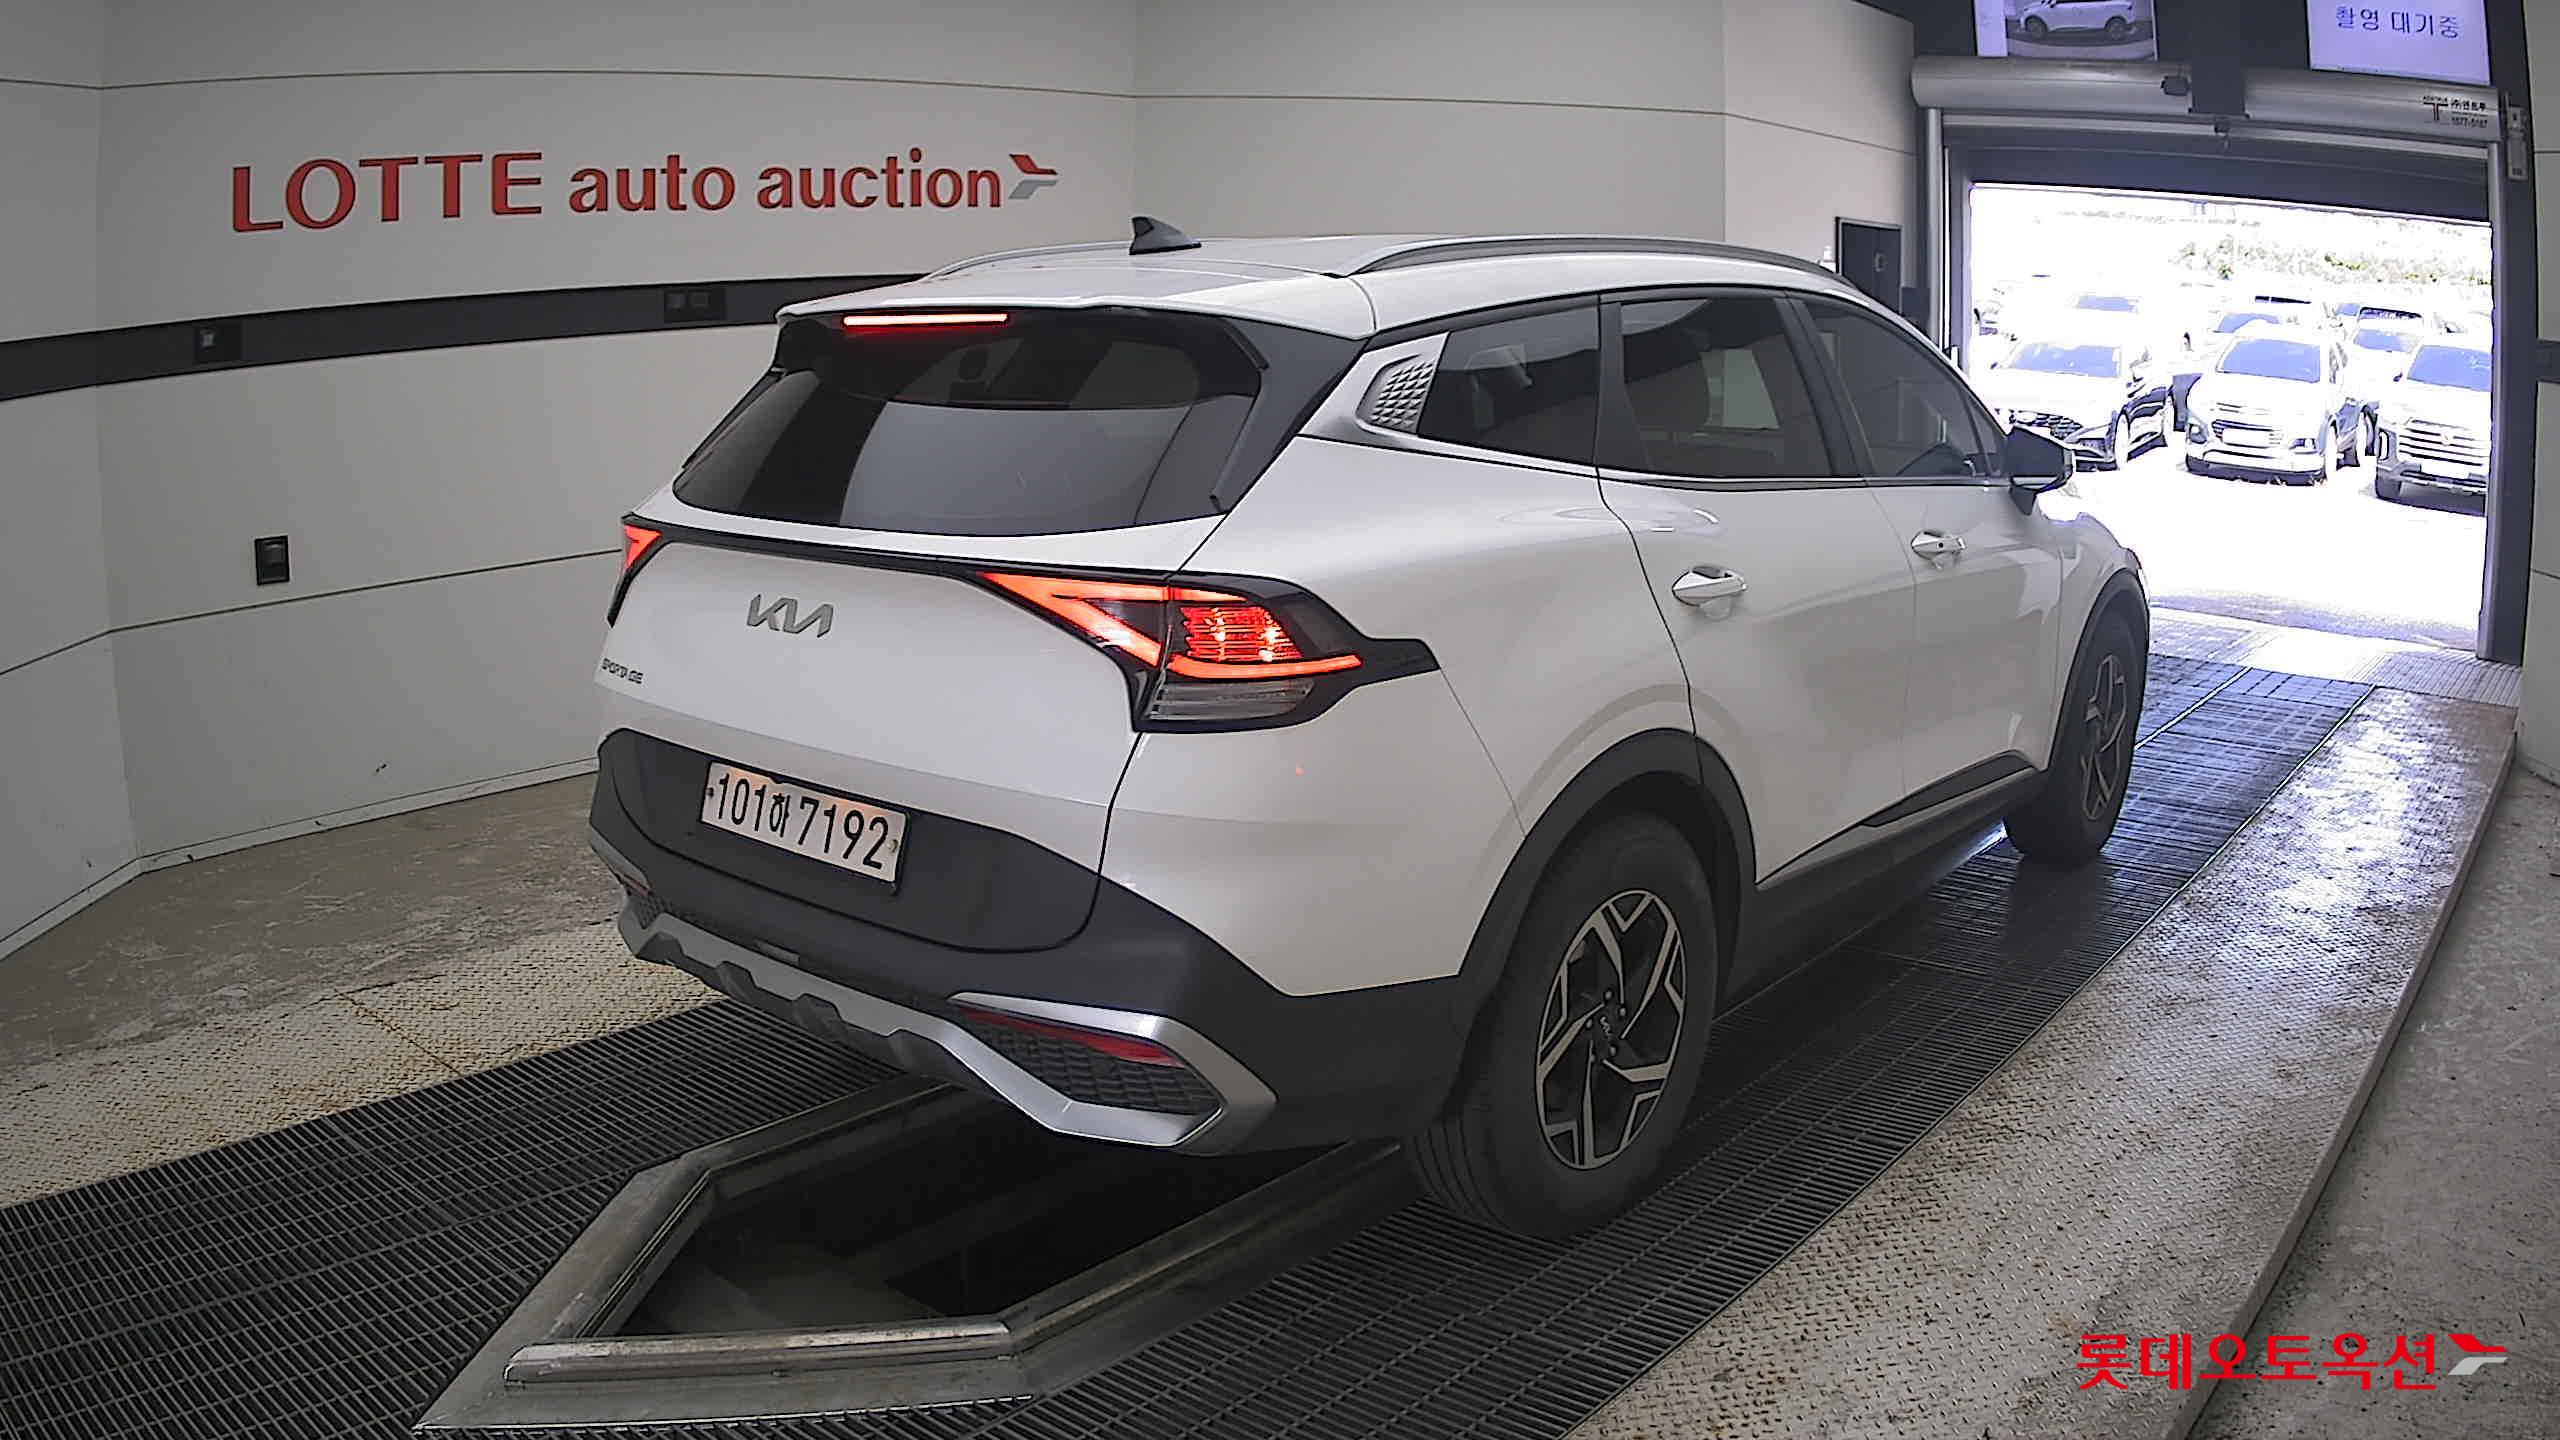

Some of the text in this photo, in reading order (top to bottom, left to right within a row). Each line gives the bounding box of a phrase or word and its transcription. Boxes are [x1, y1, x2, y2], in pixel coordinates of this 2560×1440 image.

[2336, 6, 2458, 39] 촬영 대기중
[233, 147, 1002, 233] LOTTE auto auction
[747, 593, 834, 638] KIA
